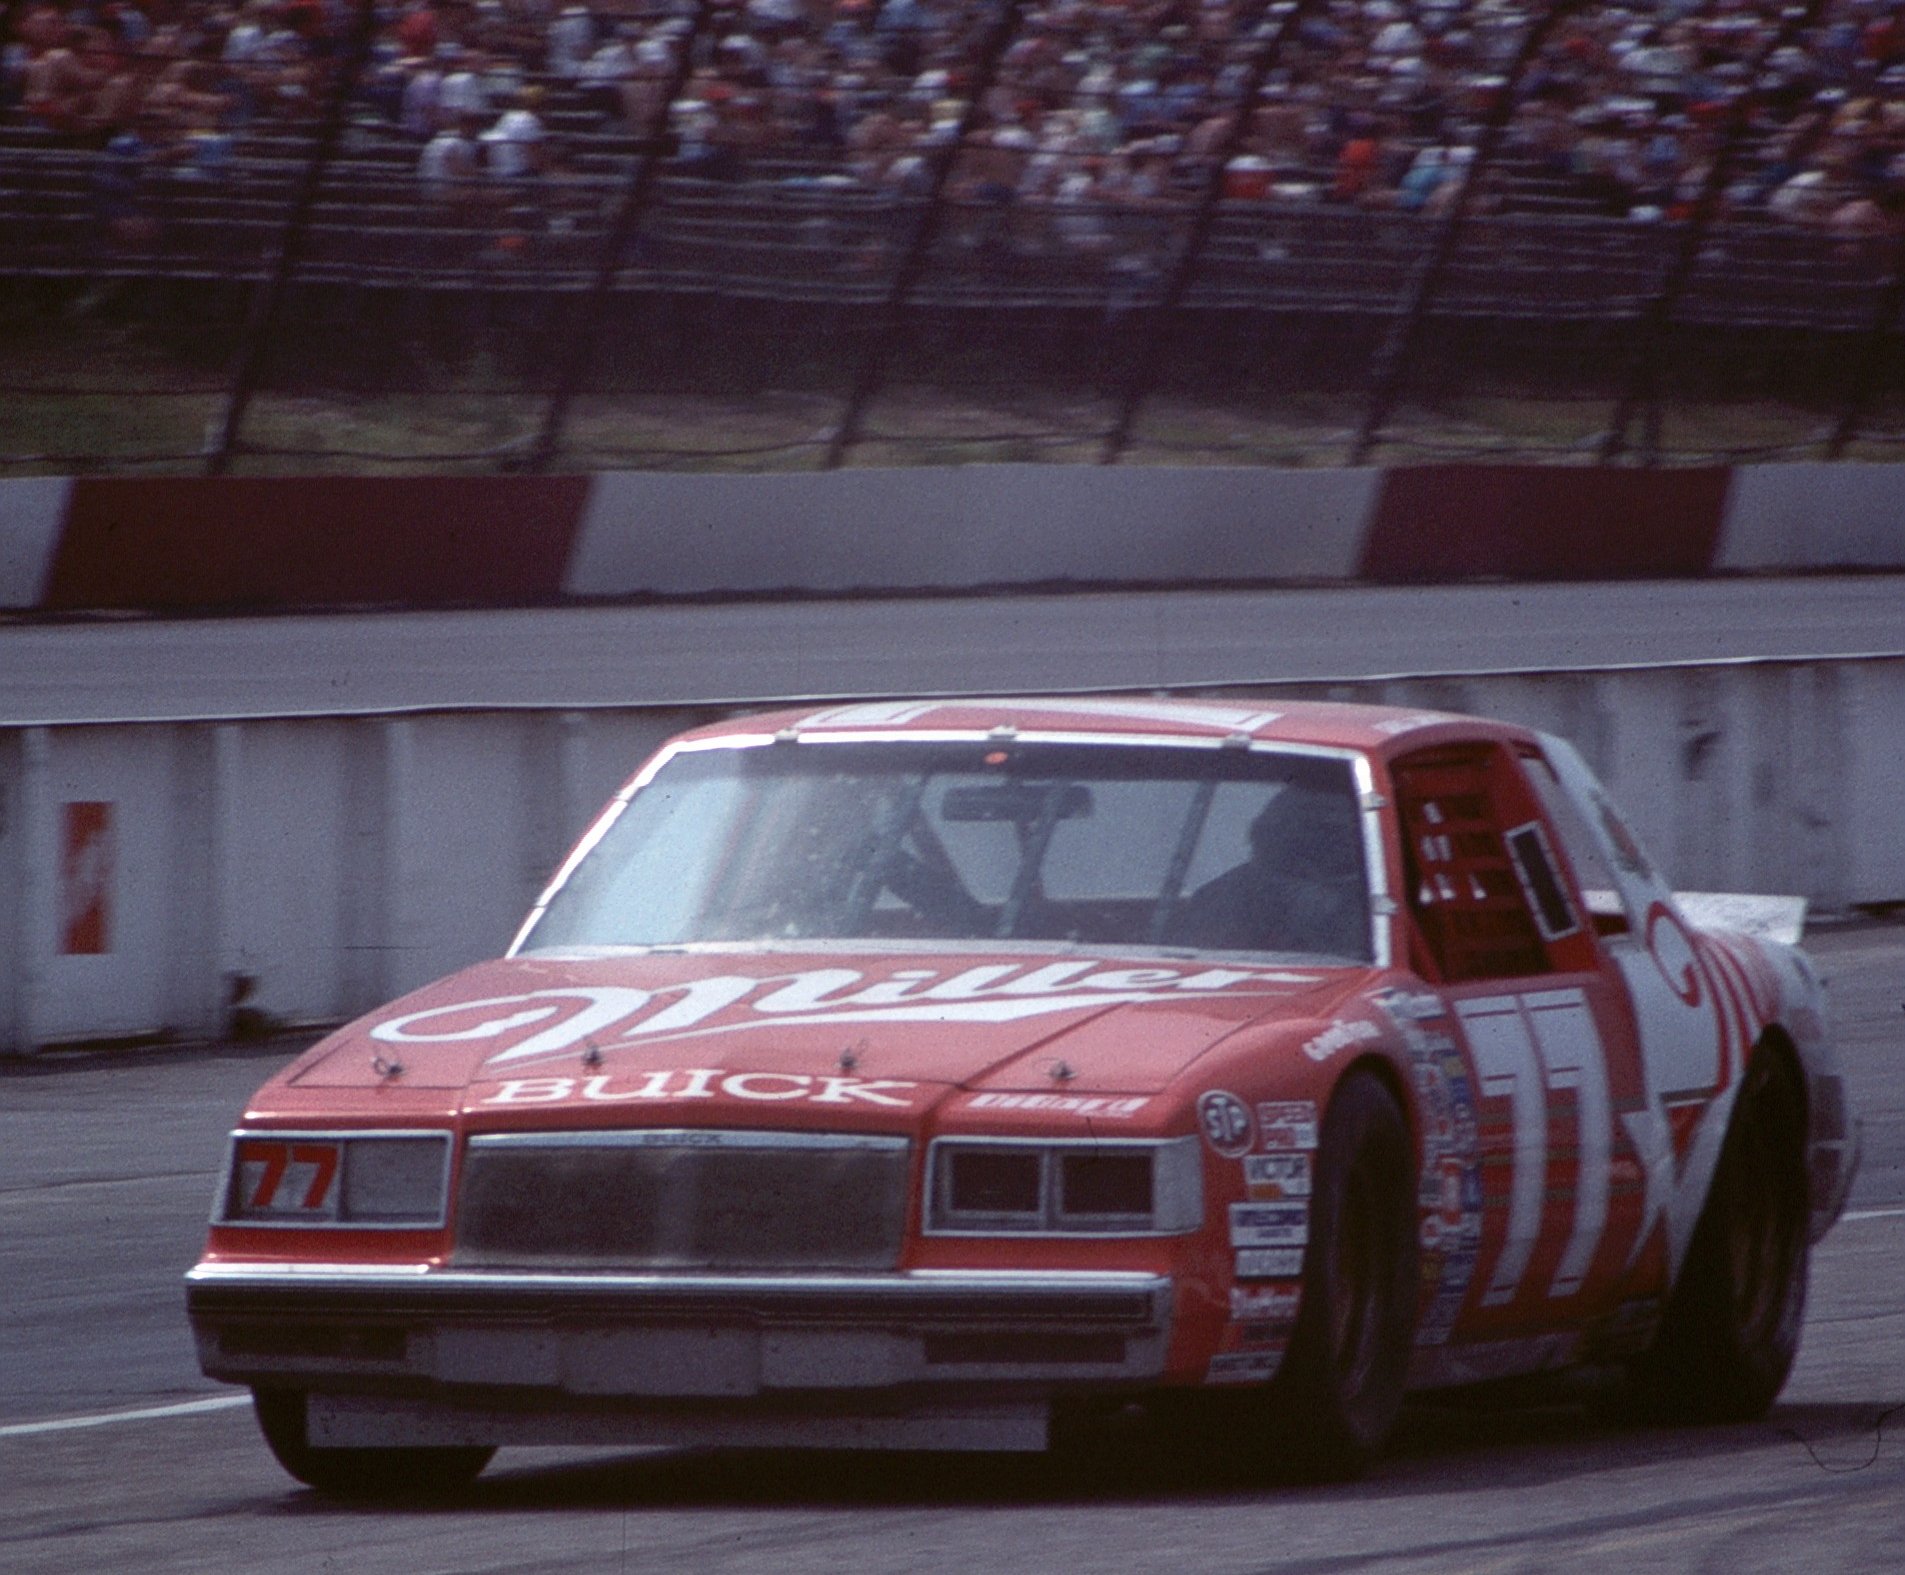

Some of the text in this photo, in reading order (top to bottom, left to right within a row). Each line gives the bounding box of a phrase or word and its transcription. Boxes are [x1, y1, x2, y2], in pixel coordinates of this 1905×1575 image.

[370, 961, 1325, 1065] Miller
[479, 1069, 918, 1106] BUICK
[1206, 1097, 1246, 1141] STP
[240, 1141, 339, 1209] 77
